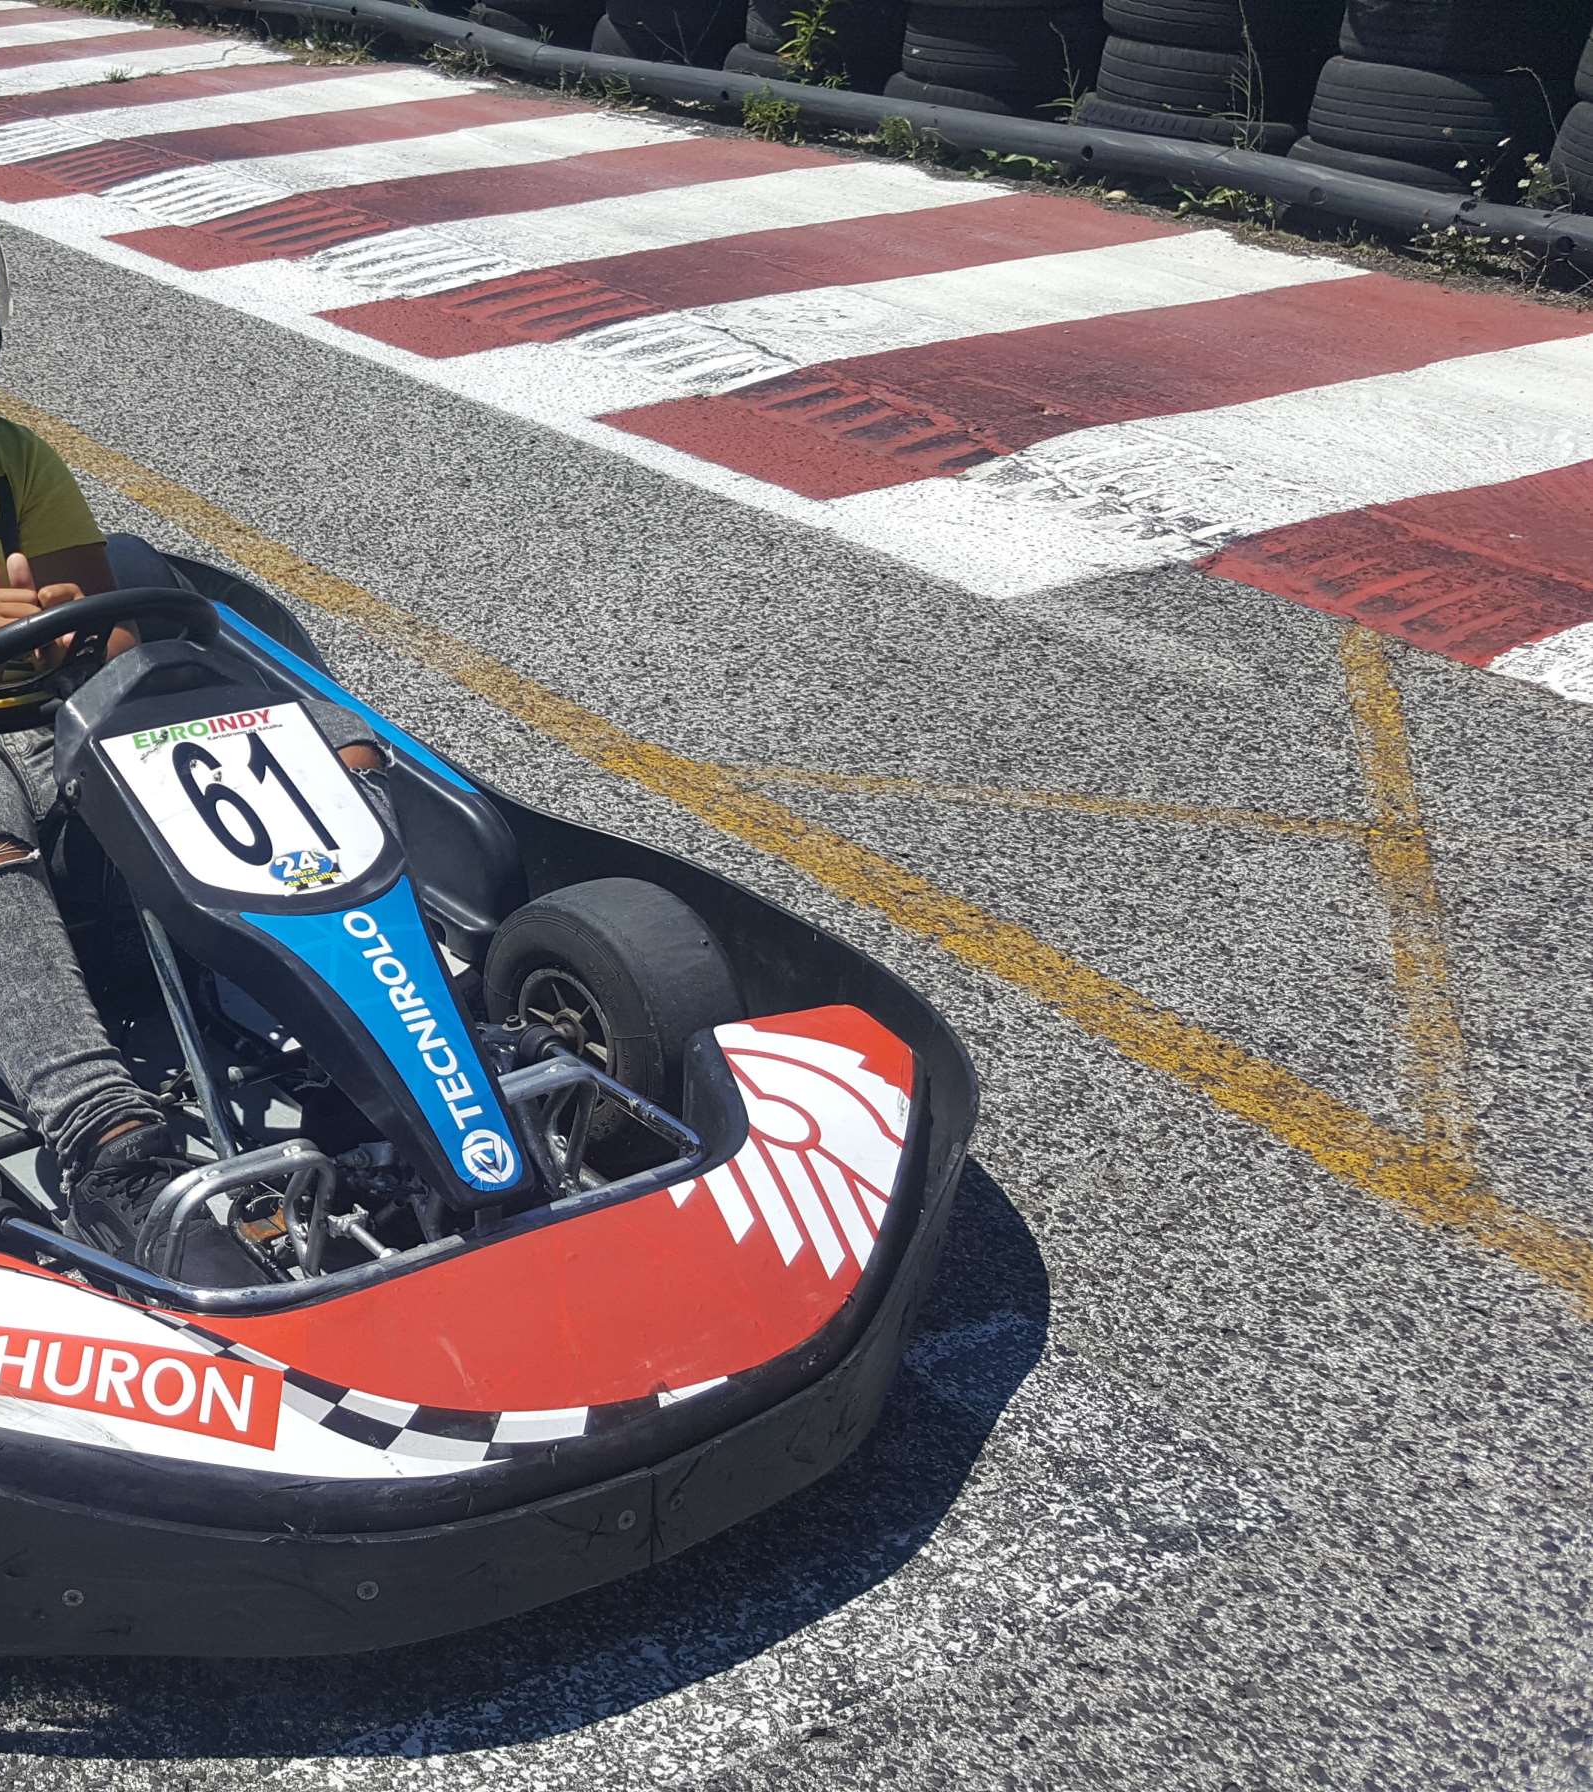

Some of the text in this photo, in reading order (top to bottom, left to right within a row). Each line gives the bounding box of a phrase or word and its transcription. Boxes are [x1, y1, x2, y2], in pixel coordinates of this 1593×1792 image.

[132, 709, 271, 750] EUROINDY
[172, 732, 340, 866] 61
[275, 851, 320, 878] 24
[342, 910, 484, 1130] TECNIROLO
